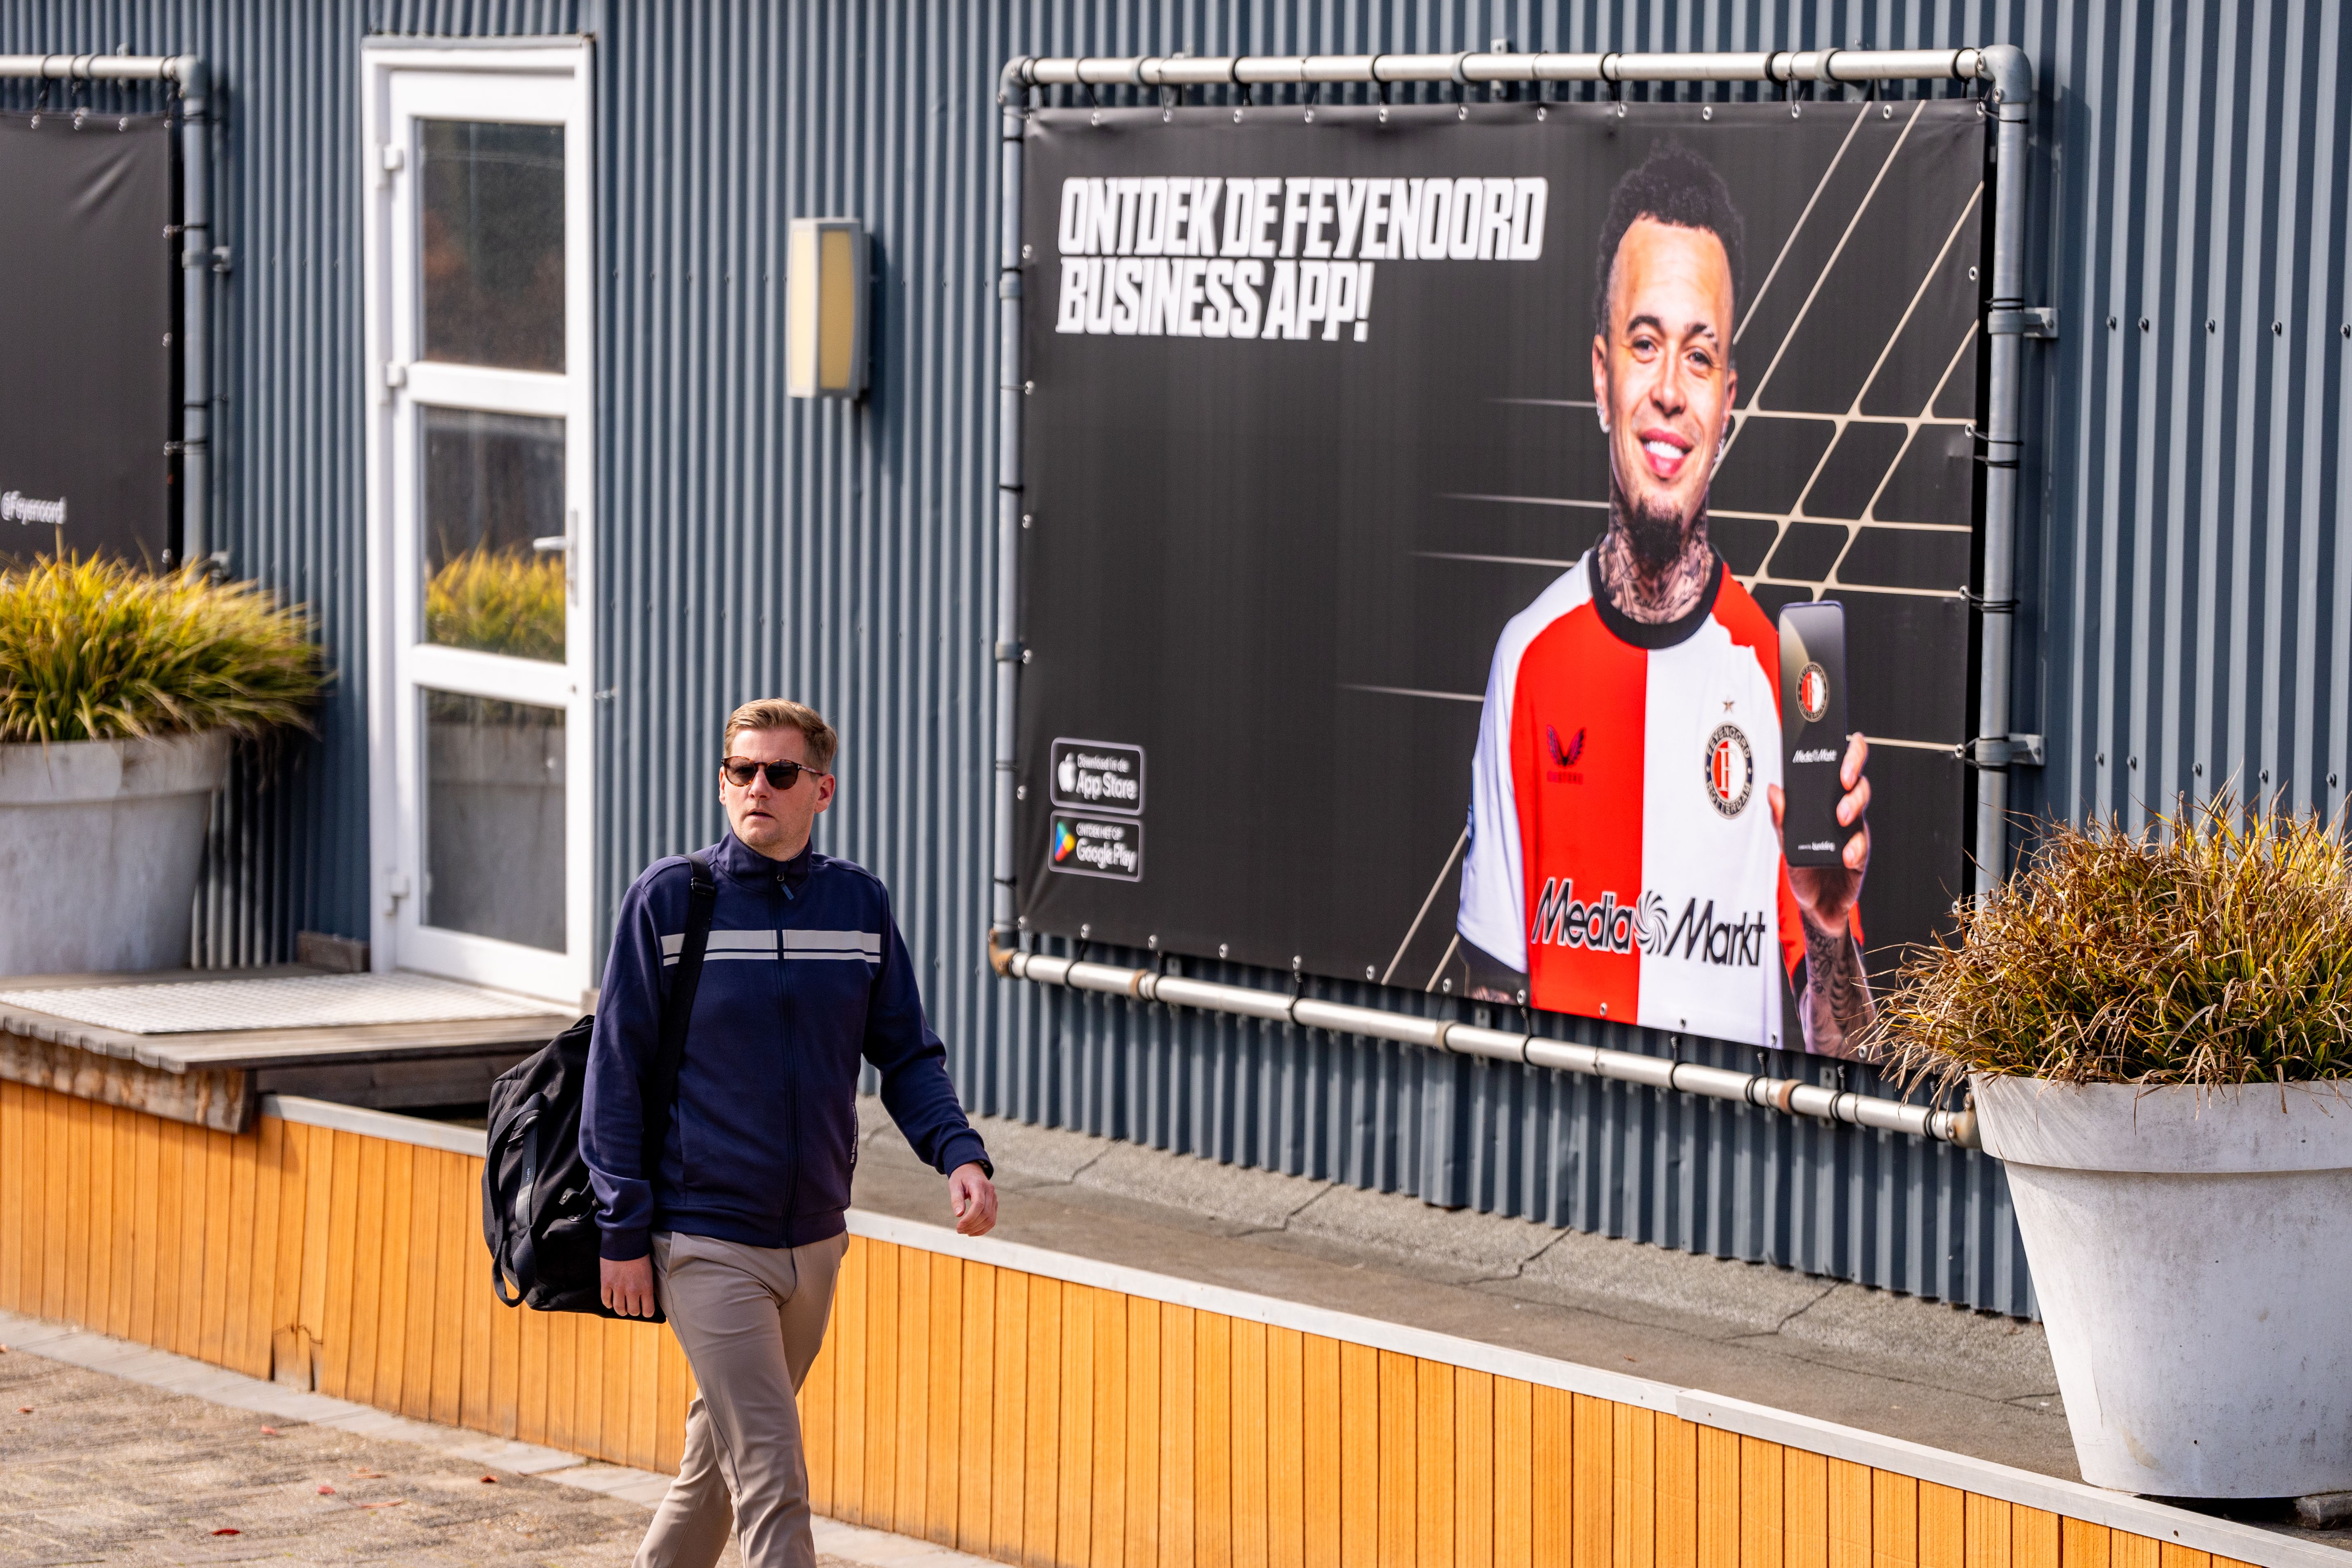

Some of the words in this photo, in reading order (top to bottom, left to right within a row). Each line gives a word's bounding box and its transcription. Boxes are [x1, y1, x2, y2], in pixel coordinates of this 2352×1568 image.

[1058, 177, 1221, 256] ONTDEK
[1220, 177, 1282, 257] DE
[1279, 178, 1548, 260] FEYENOORD
[1055, 257, 1264, 339] BUSINESS
[1261, 260, 1375, 342] APP!
[1, 490, 67, 526] @Feyenoord
[1706, 725, 1751, 759] FEYENOORD
[1078, 753, 1110, 771] Download
[1118, 757, 1131, 773] de
[1076, 769, 1102, 800] App
[1102, 771, 1139, 800] Store
[1707, 780, 1751, 815] ROTTERDAM
[1076, 823, 1101, 838] ONTDEK
[1112, 826, 1125, 840] OP
[1076, 837, 1113, 869] Google
[1113, 842, 1138, 872] Play
[1531, 877, 1635, 954] Media
[1662, 897, 1765, 966] Markt
